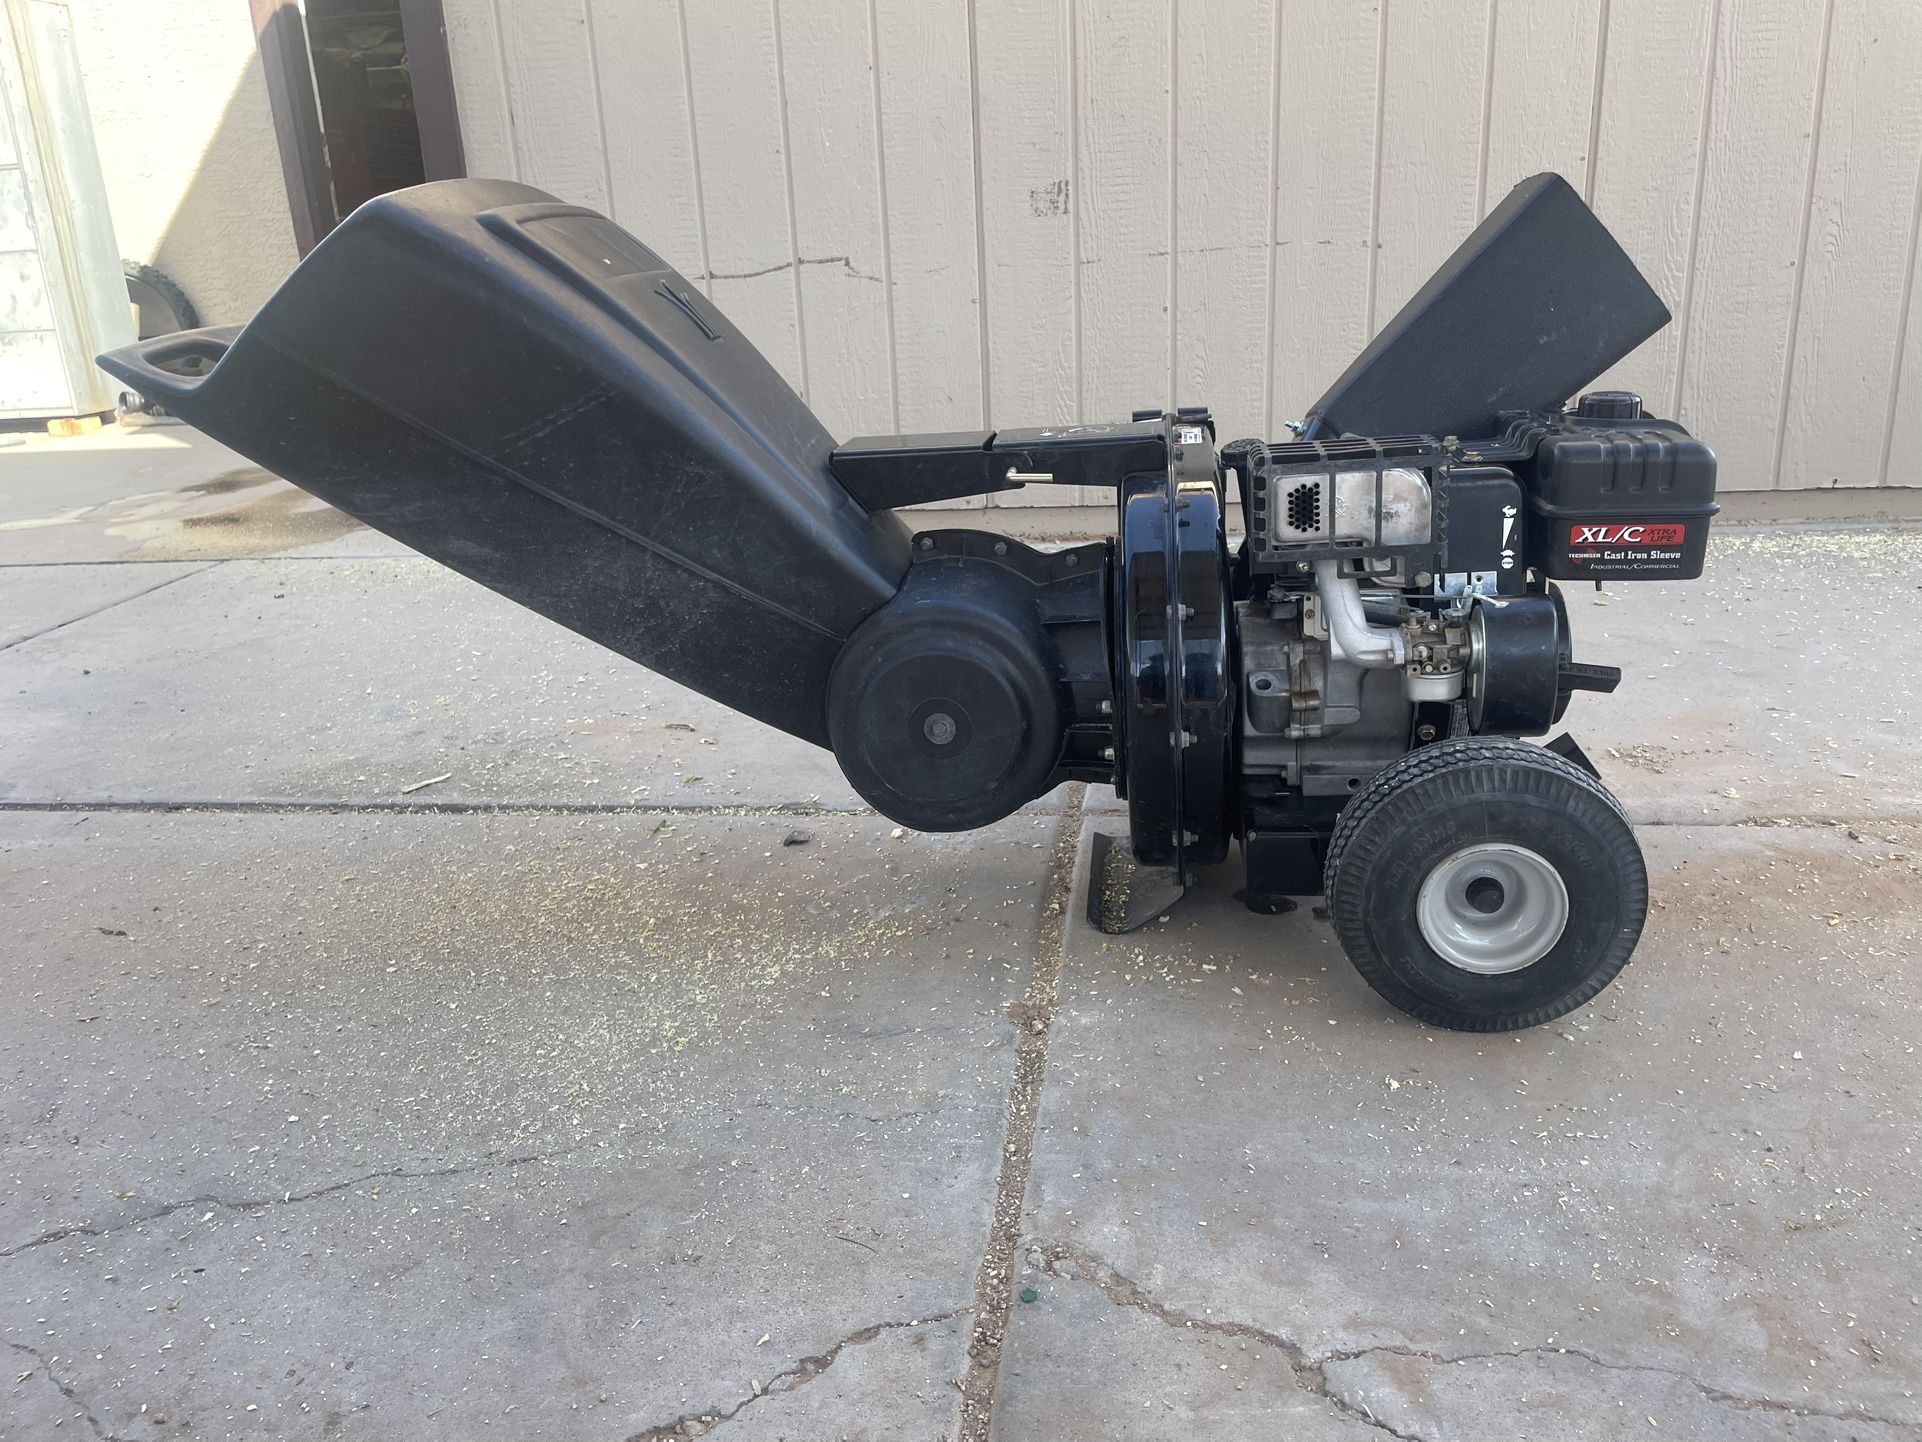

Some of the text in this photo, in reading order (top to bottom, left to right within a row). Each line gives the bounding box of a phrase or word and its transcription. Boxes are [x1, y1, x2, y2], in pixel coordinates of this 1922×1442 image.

[1575, 526, 1645, 543] XL/C
[1648, 528, 1678, 536] XTRA
[1604, 550, 1681, 560] Cast Iron Sleeve
